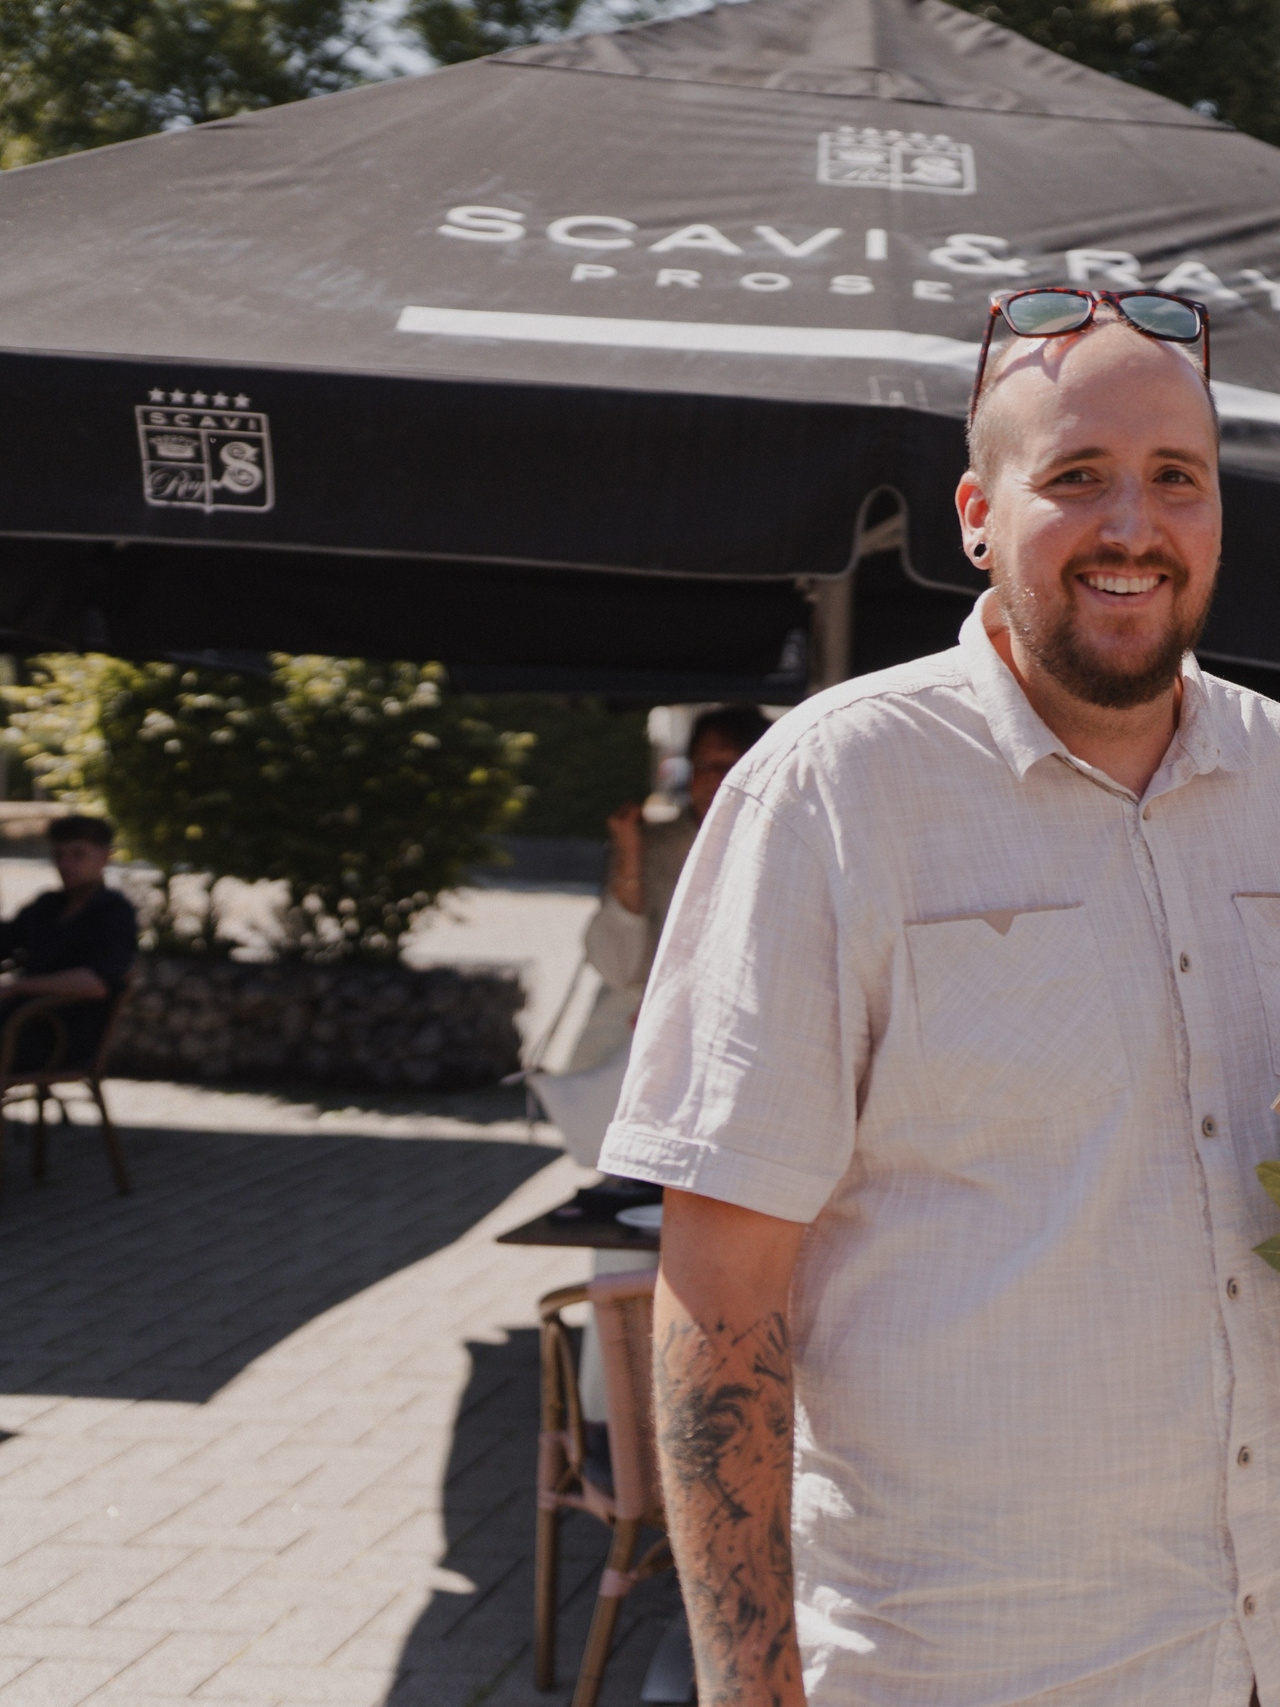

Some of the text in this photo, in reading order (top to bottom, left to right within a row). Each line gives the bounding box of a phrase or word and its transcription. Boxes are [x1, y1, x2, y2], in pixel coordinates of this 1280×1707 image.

[437, 205, 888, 260] SCAVI
[929, 233, 1030, 277] &
[571, 264, 1020, 302] PROSE
[149, 411, 259, 431] SCAVI
